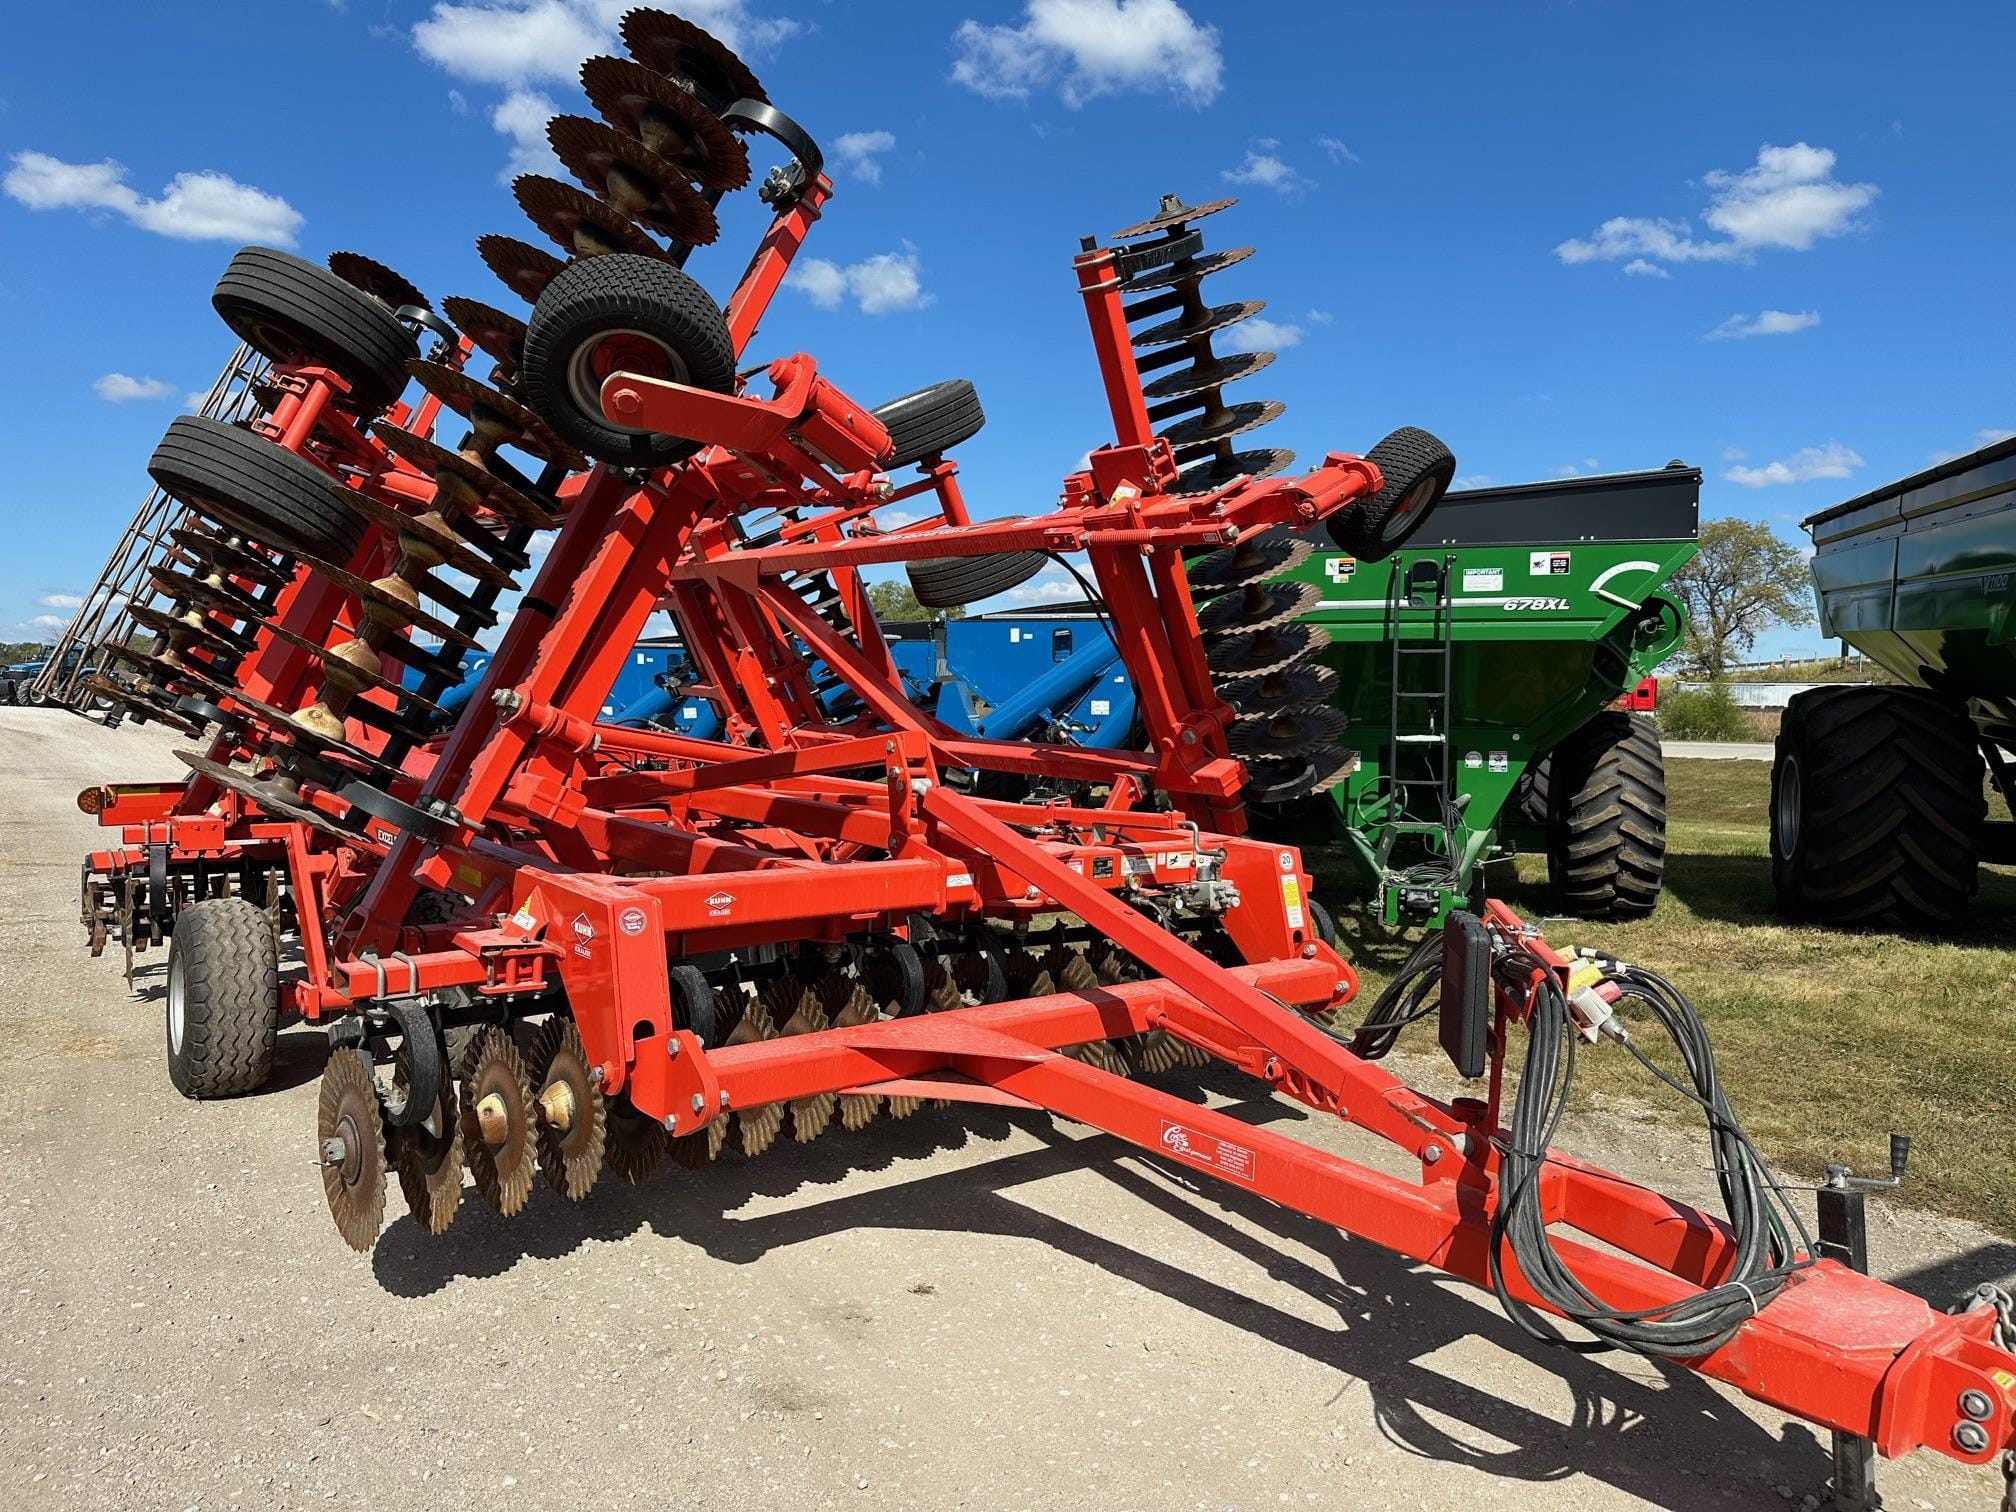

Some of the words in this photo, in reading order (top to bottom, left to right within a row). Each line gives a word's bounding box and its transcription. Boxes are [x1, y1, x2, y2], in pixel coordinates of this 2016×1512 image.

[1503, 598, 1570, 611] 678XL
[1281, 855, 1291, 865] 20
[708, 896, 732, 906] KUHN
[574, 921, 592, 939] KUHN
